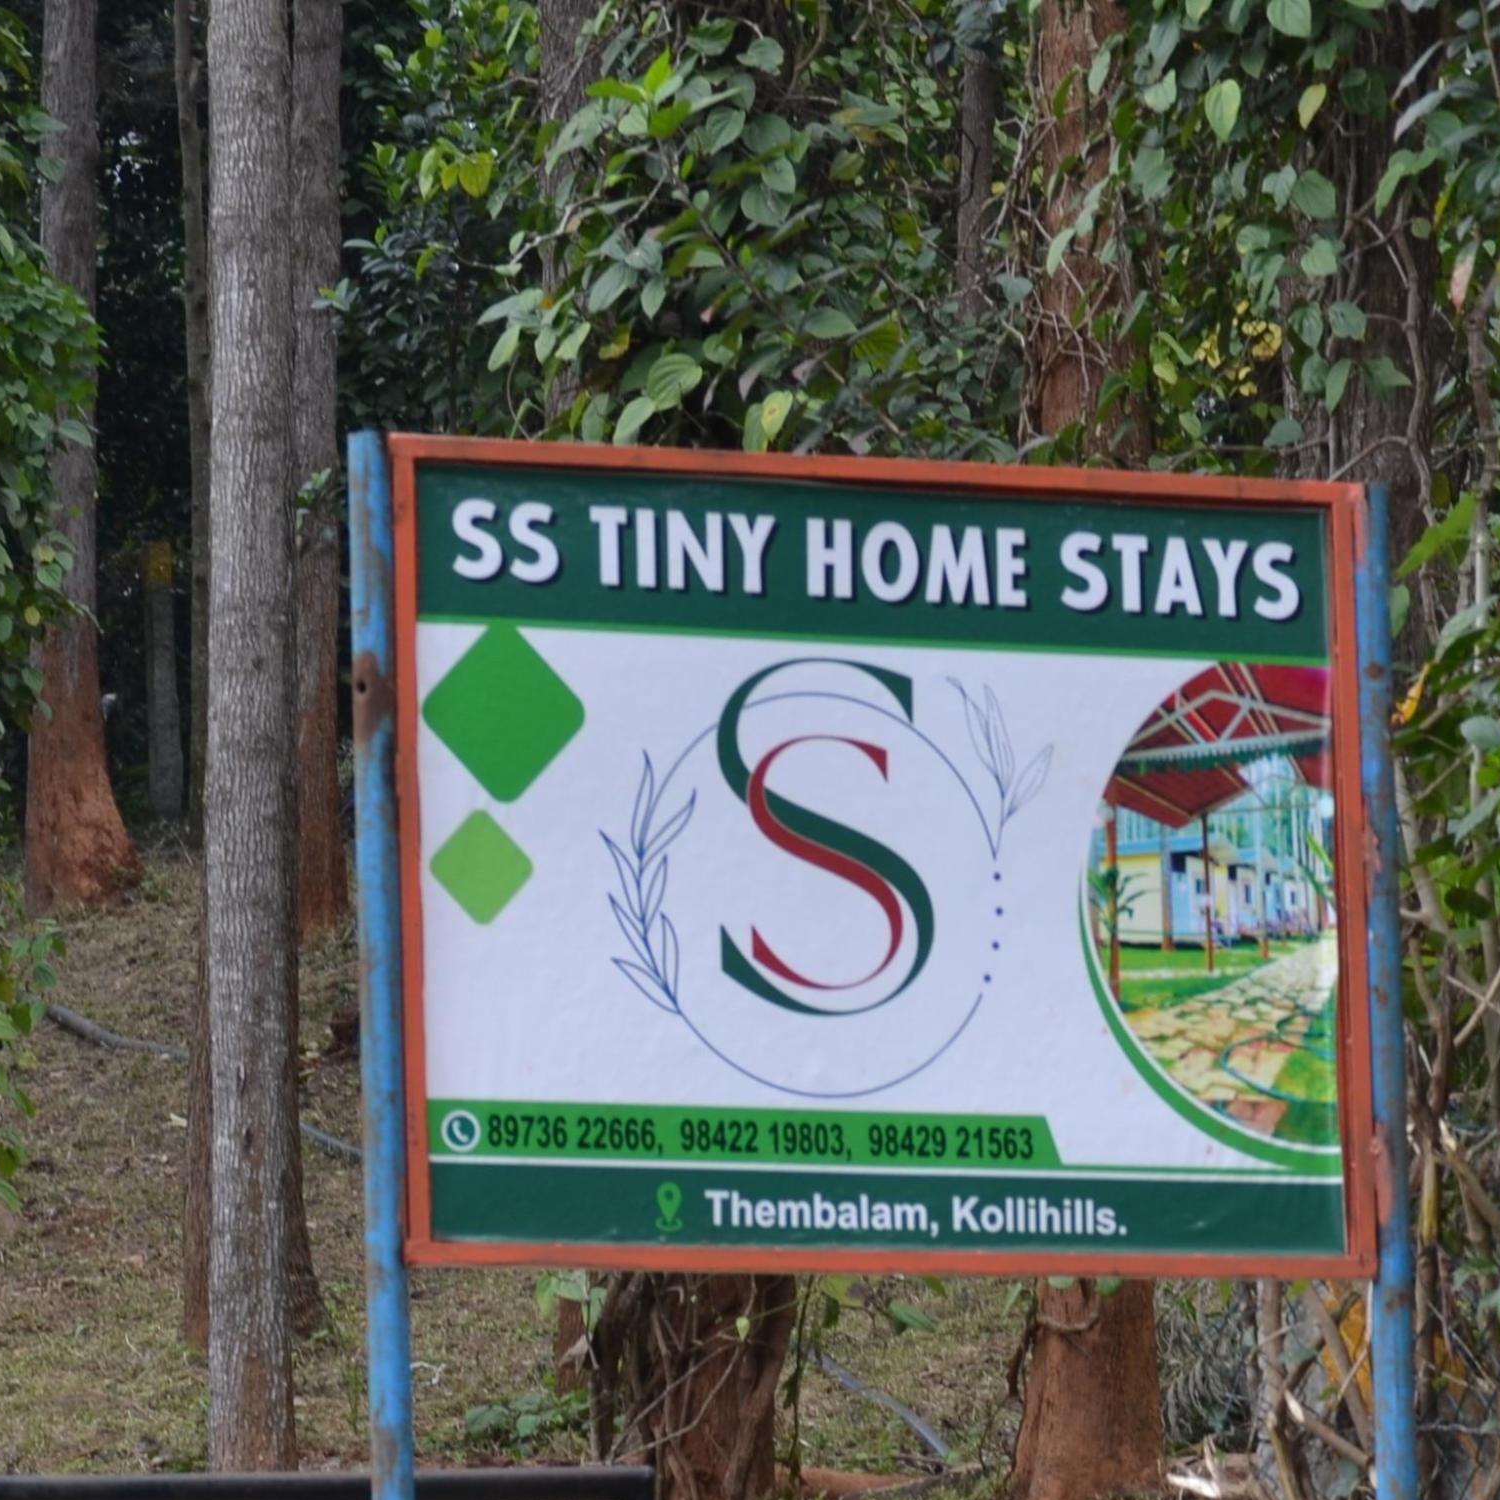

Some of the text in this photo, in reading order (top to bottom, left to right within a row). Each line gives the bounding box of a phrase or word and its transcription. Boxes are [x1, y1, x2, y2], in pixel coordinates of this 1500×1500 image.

[451, 499, 1300, 620] SS TINY HOME STAYS
[487, 1113, 1035, 1161] 89736 22666, 98422 19803, 98429 21563
[704, 1189, 1128, 1239] Thembalam, Kollihills.
